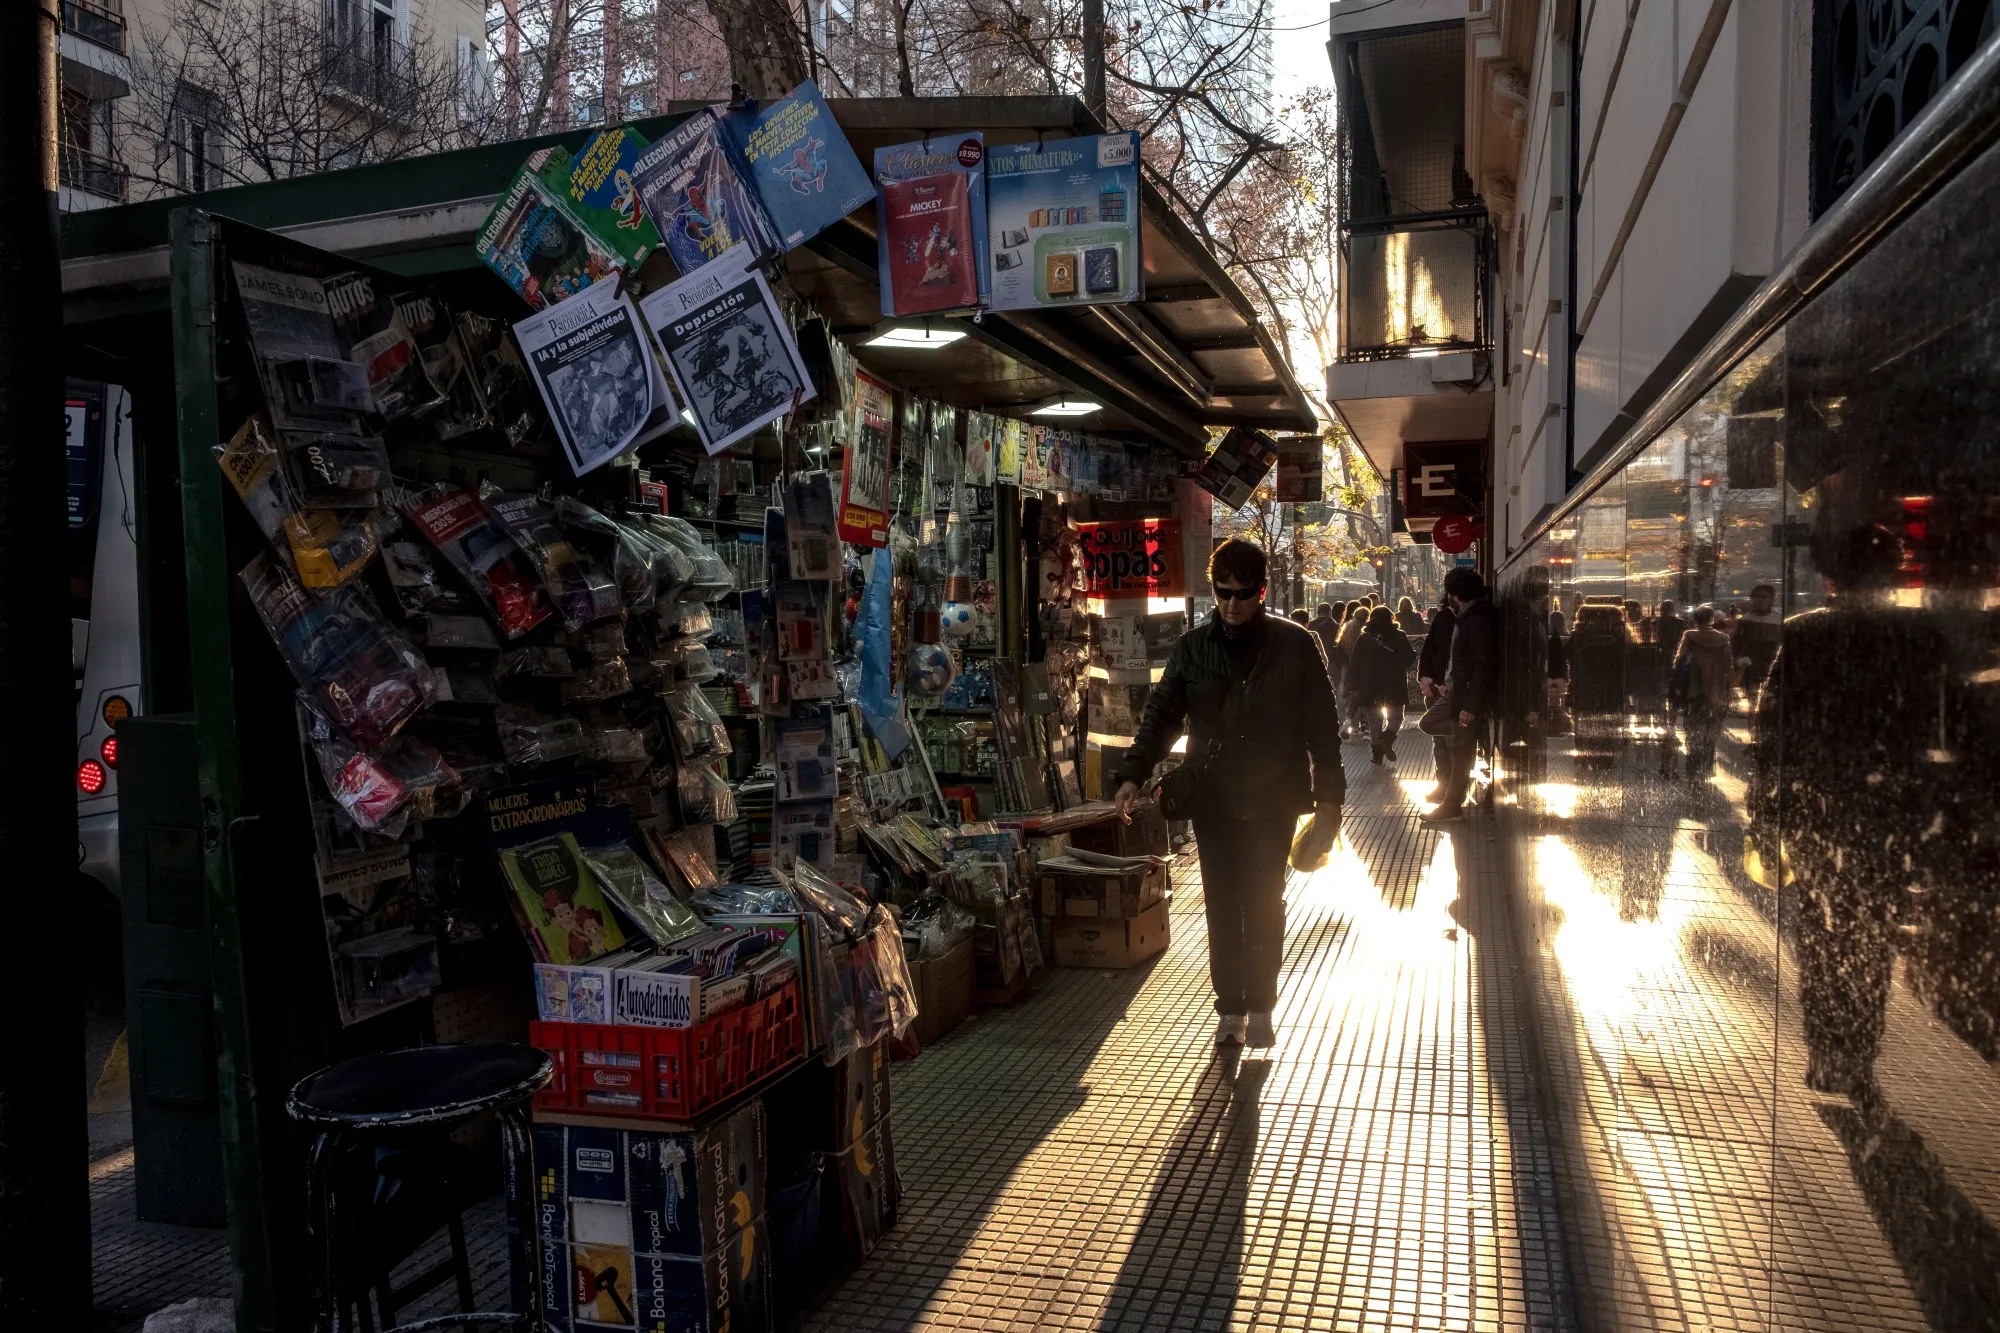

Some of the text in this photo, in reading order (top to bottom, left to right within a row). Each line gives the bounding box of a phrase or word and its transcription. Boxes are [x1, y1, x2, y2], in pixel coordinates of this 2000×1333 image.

[632, 140, 679, 178] COLECCIÓN
[676, 113, 716, 146] CLÁSICA
[744, 100, 814, 157] DE MARVEL REVIVEN
[749, 126, 763, 143] LOS
[749, 153, 759, 164] EN
[760, 138, 779, 155] ESTA
[958, 149, 980, 159] $9.990
[988, 156, 1014, 174] NTOS
[1020, 150, 1074, 170] MINIATURA
[1103, 147, 1132, 160] $5.000
[570, 166, 582, 184] LOS
[570, 184, 580, 198] DE
[577, 159, 599, 185] MARVEL
[576, 189, 586, 202] EN
[584, 170, 600, 189] ESTA
[642, 142, 714, 198] COLECCIÓN CLÁSICA
[671, 170, 696, 193] MARVEL
[476, 206, 511, 254] COLECCIÓN
[506, 171, 533, 209] CLÁSICA
[909, 199, 943, 213] MICKEY
[240, 276, 323, 305] JAMES BOND
[327, 276, 376, 318] AUTOS
[402, 298, 436, 329] UTOS
[674, 292, 745, 336] Depresión
[537, 310, 626, 362] IA y la subjetividad
[308, 446, 338, 485] 007
[429, 519, 447, 534] 230
[502, 509, 530, 523] BEETLE
[1080, 532, 1167, 590] Sopas
[488, 792, 529, 813] MUJERES
[490, 797, 587, 833] EXTRAORDINARIAS
[617, 975, 691, 1021] Autodefinidos
[632, 1017, 657, 1026] Plus
[707, 1142, 730, 1312] BananaTropical
[541, 1204, 560, 1312] BananaTropical
[644, 1210, 666, 1319] BananaTropical
